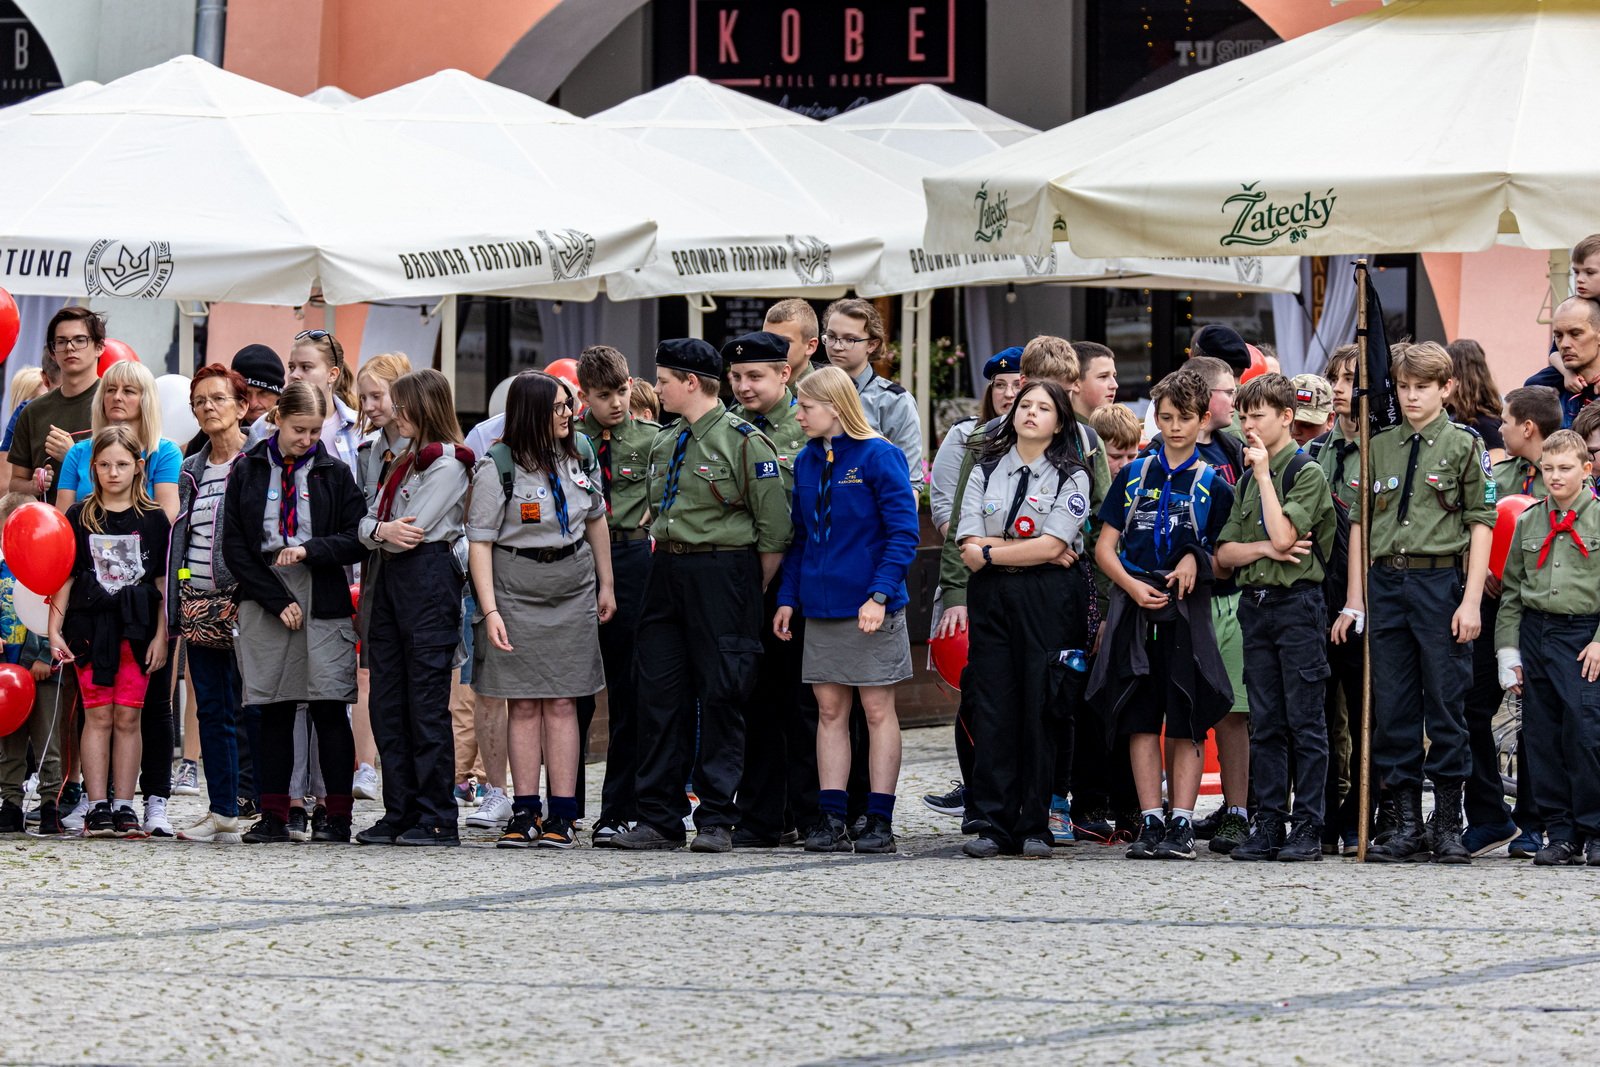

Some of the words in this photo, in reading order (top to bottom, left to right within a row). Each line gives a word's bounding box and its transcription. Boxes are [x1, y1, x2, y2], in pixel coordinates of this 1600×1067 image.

[719, 7, 926, 63] KOBE
[763, 74, 814, 88] GRILL
[829, 73, 884, 88] HOUSE
[974, 179, 1008, 243] Žatecký
[1220, 180, 1338, 247] Žatecký
[0, 248, 72, 278] TUNA
[87, 239, 110, 265] WARZYM
[398, 248, 471, 280] BROWAR
[468, 240, 543, 272] FORTUNA
[671, 247, 729, 276] BROWAR
[729, 245, 788, 272] FORTUNA
[763, 462, 774, 473] 39
